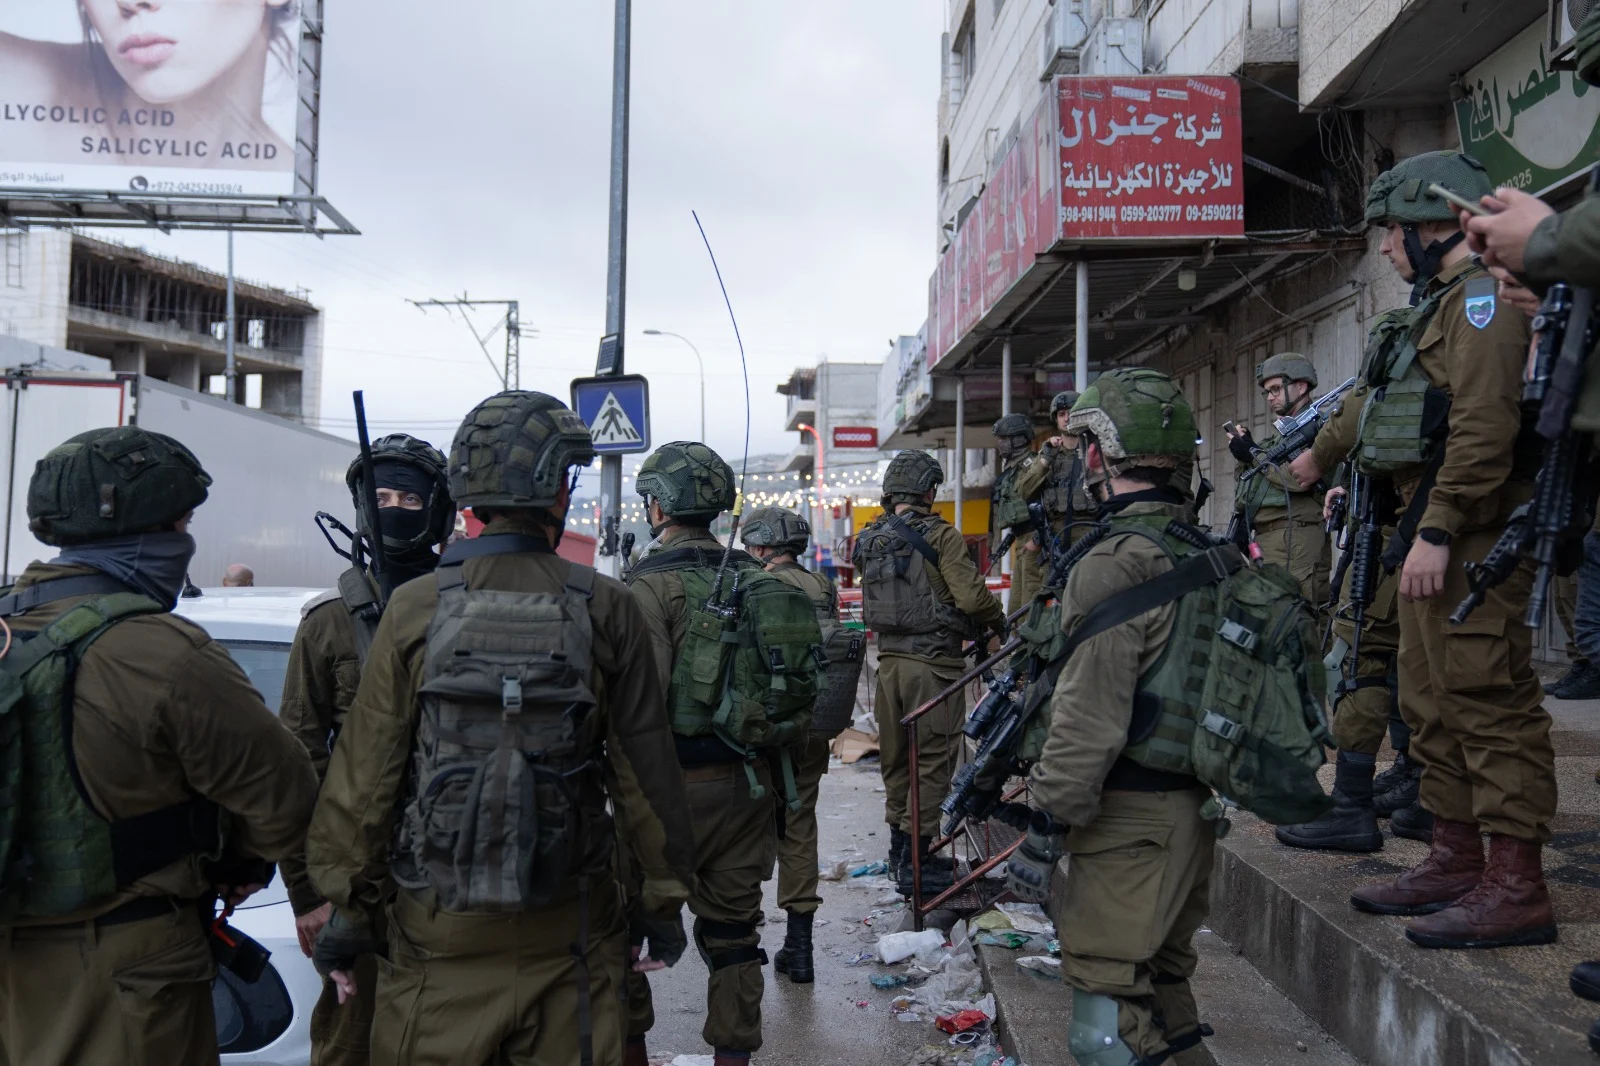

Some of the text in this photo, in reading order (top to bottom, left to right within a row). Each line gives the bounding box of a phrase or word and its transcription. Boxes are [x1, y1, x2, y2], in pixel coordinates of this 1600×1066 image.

[1187, 79, 1227, 100] PHILIPS
[118, 109, 175, 127] ACID
[1060, 104, 1223, 148] شركة جنرال
[81, 136, 278, 160] SALICYLIC ACID
[1063, 158, 1233, 198] للأجهزة الكهربائية
[1121, 205, 1181, 222] 0599-203777
[1186, 204, 1244, 221] 09-2590212
